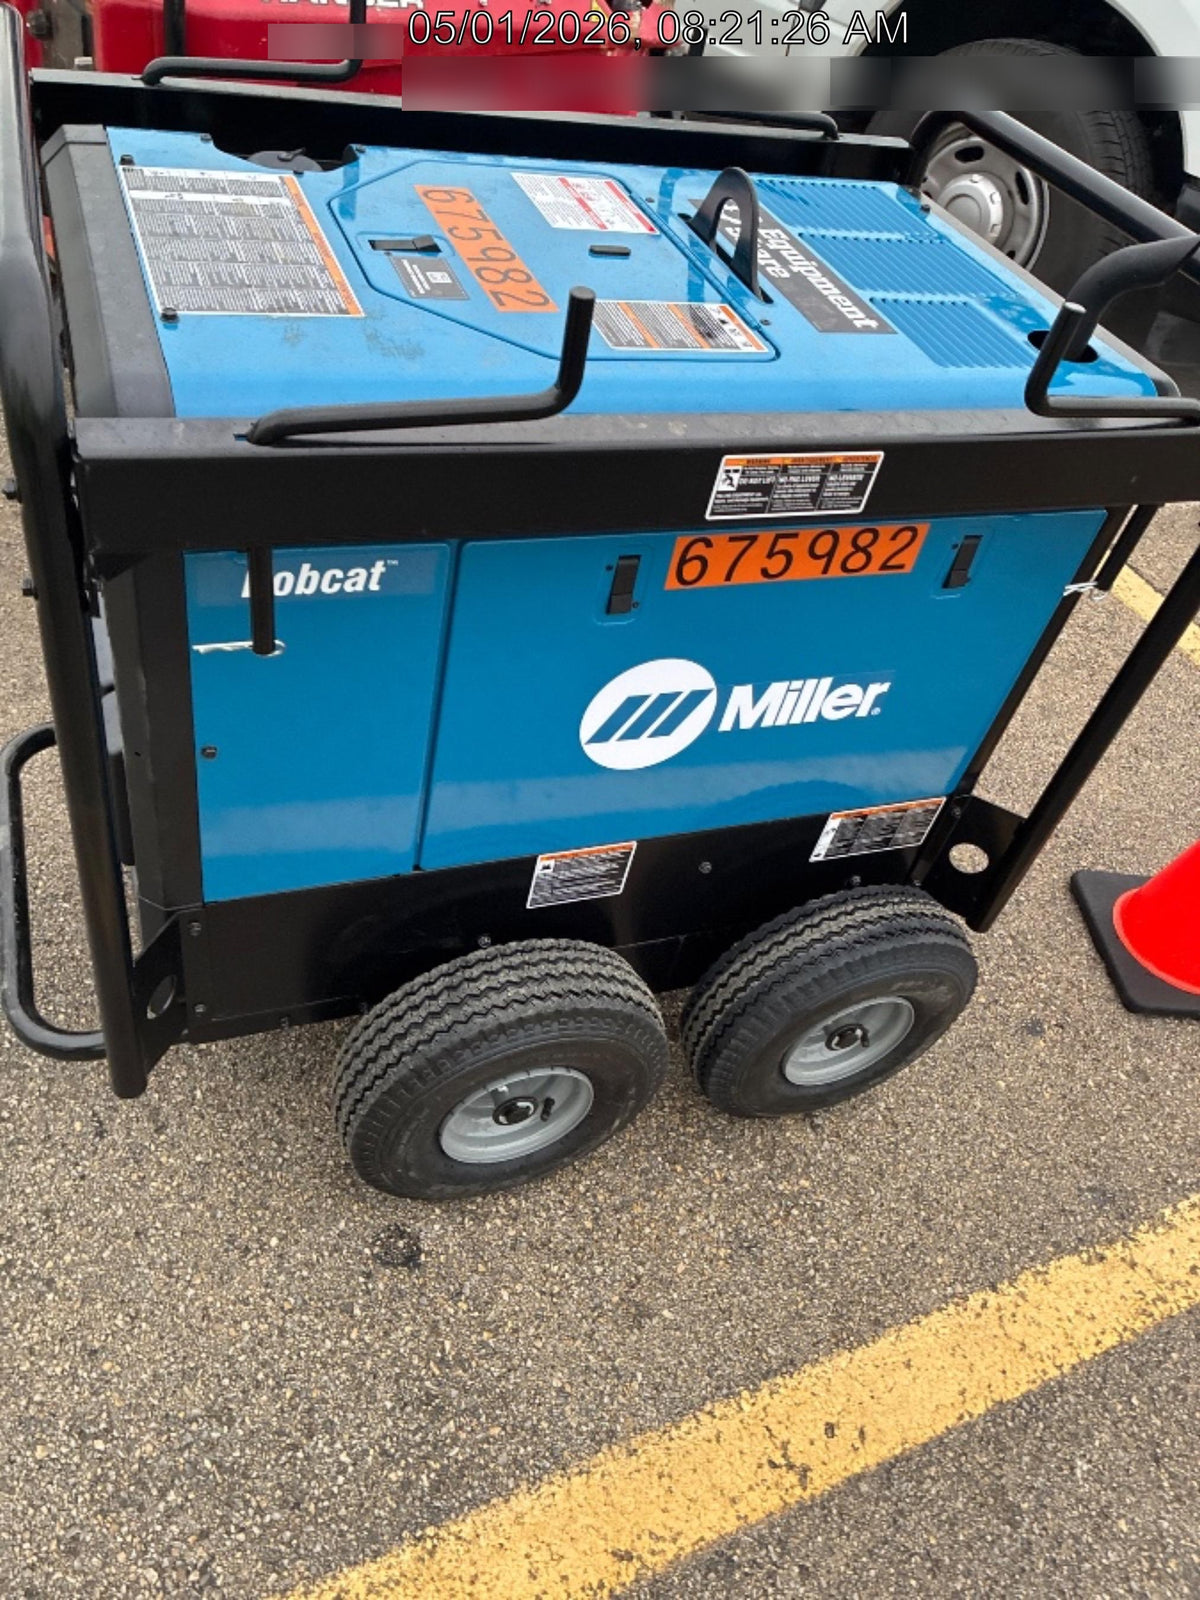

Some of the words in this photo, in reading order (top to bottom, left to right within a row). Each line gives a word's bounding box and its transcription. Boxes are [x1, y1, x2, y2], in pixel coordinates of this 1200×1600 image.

[423, 188, 551, 308] 675982
[757, 228, 880, 329] Equipment
[675, 526, 918, 586] 675982
[718, 676, 892, 732] Miller
